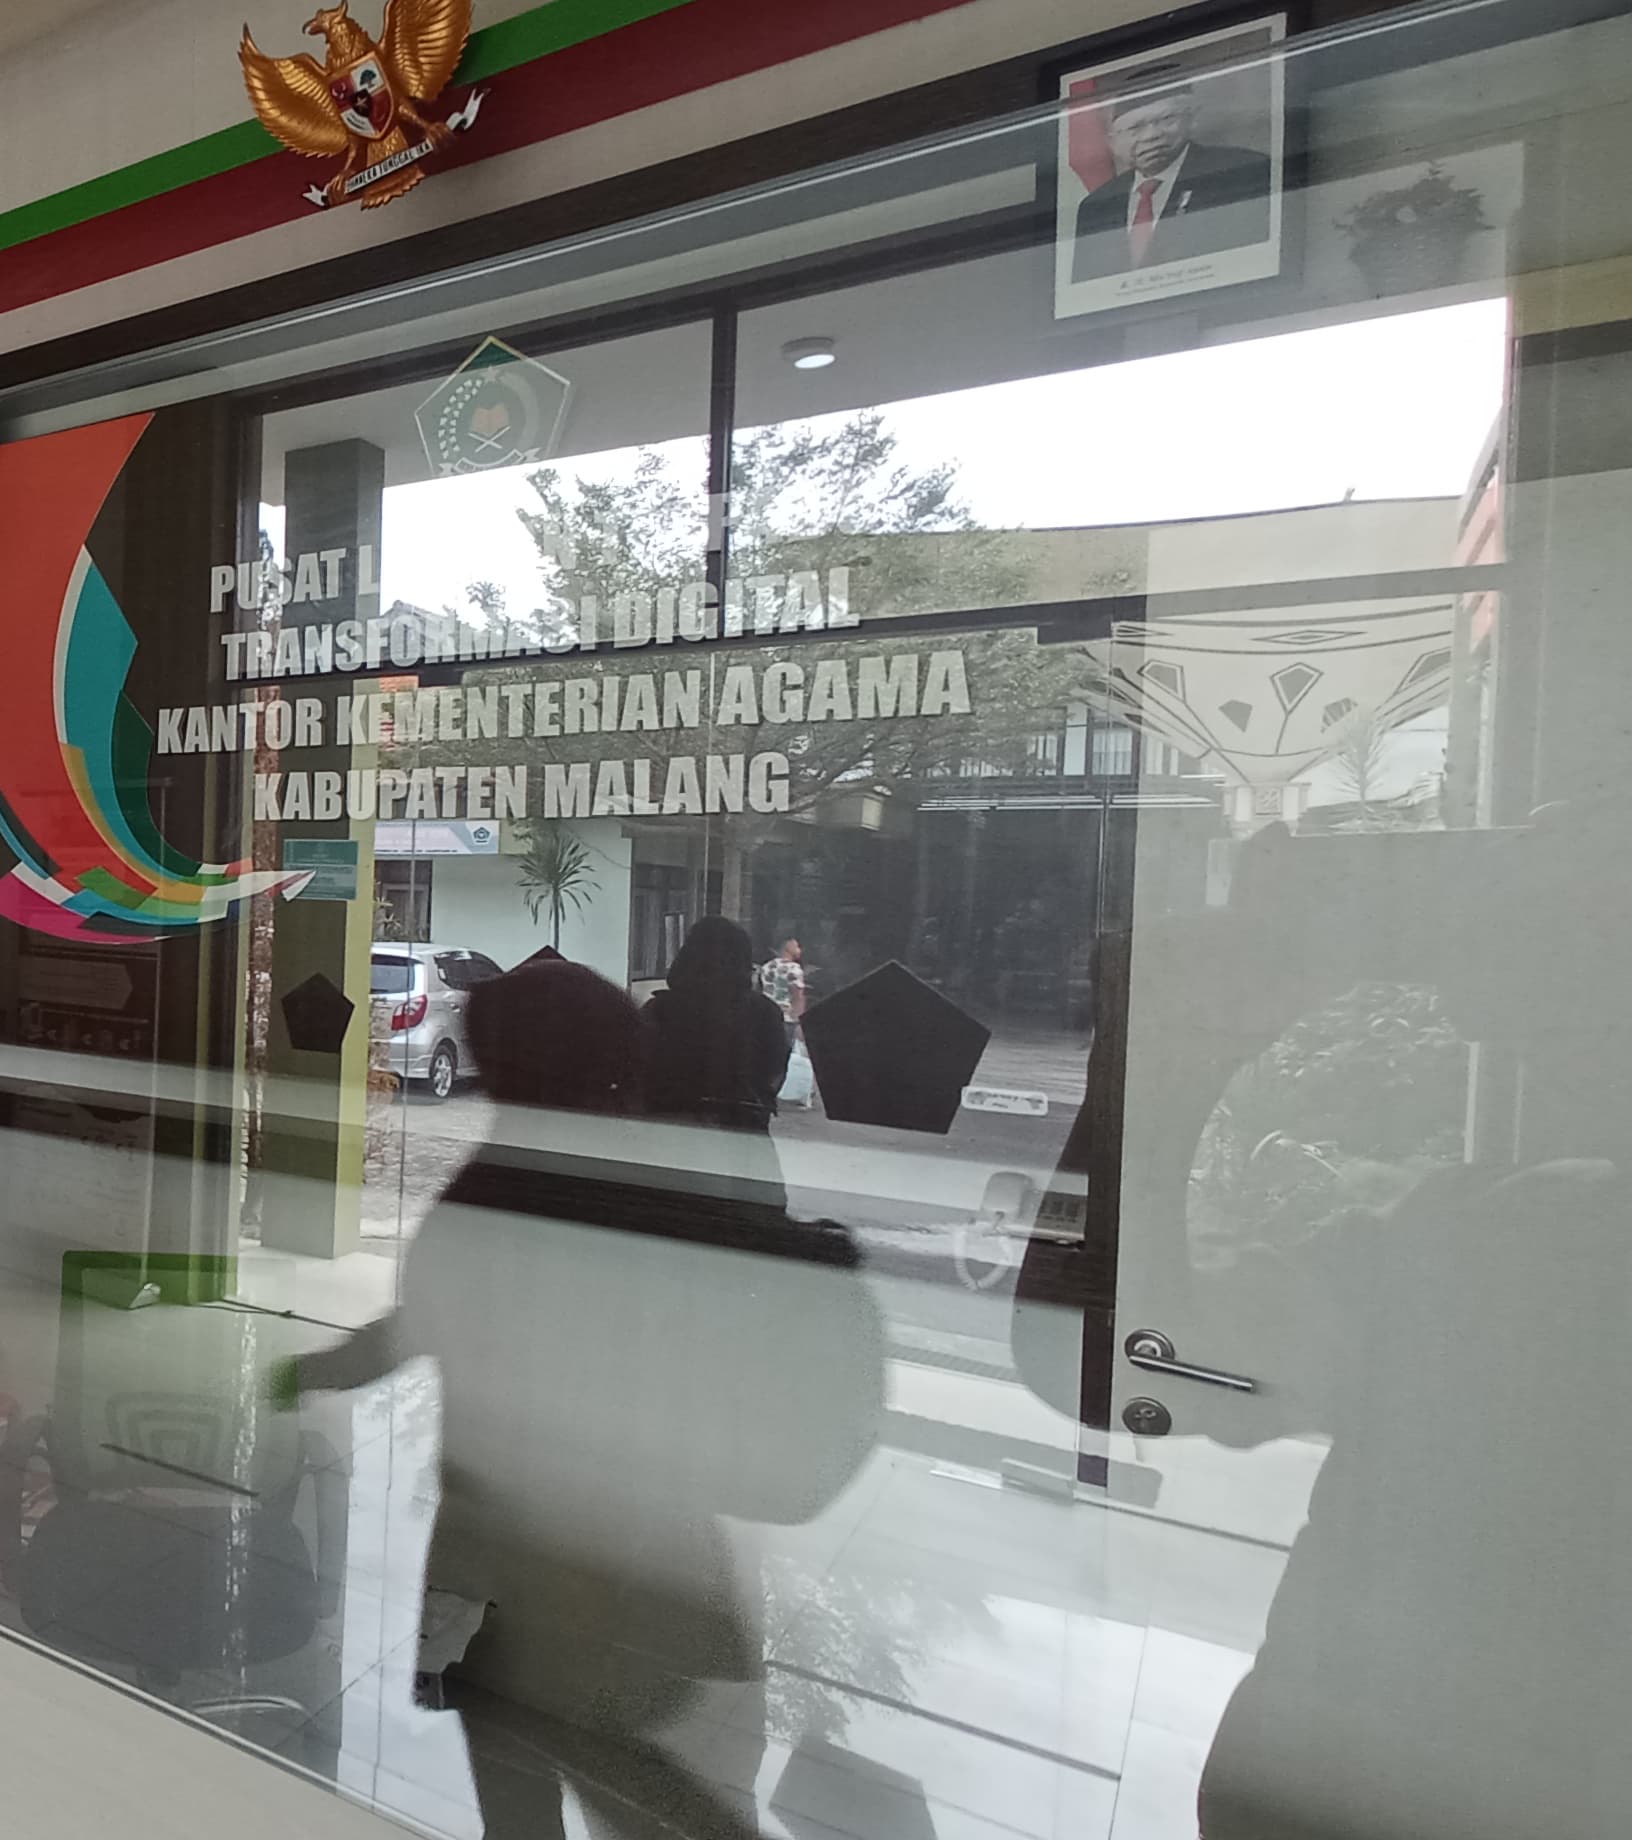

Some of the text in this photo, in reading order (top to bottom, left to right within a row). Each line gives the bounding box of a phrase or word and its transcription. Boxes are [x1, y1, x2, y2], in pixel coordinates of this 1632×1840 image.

[210, 548, 347, 613] PUSAT
[613, 566, 861, 650] DIGITAL
[157, 650, 971, 755] KANTOR KEMENTERIAN AGAMA
[252, 751, 791, 823] KABUPATEN MALANG
